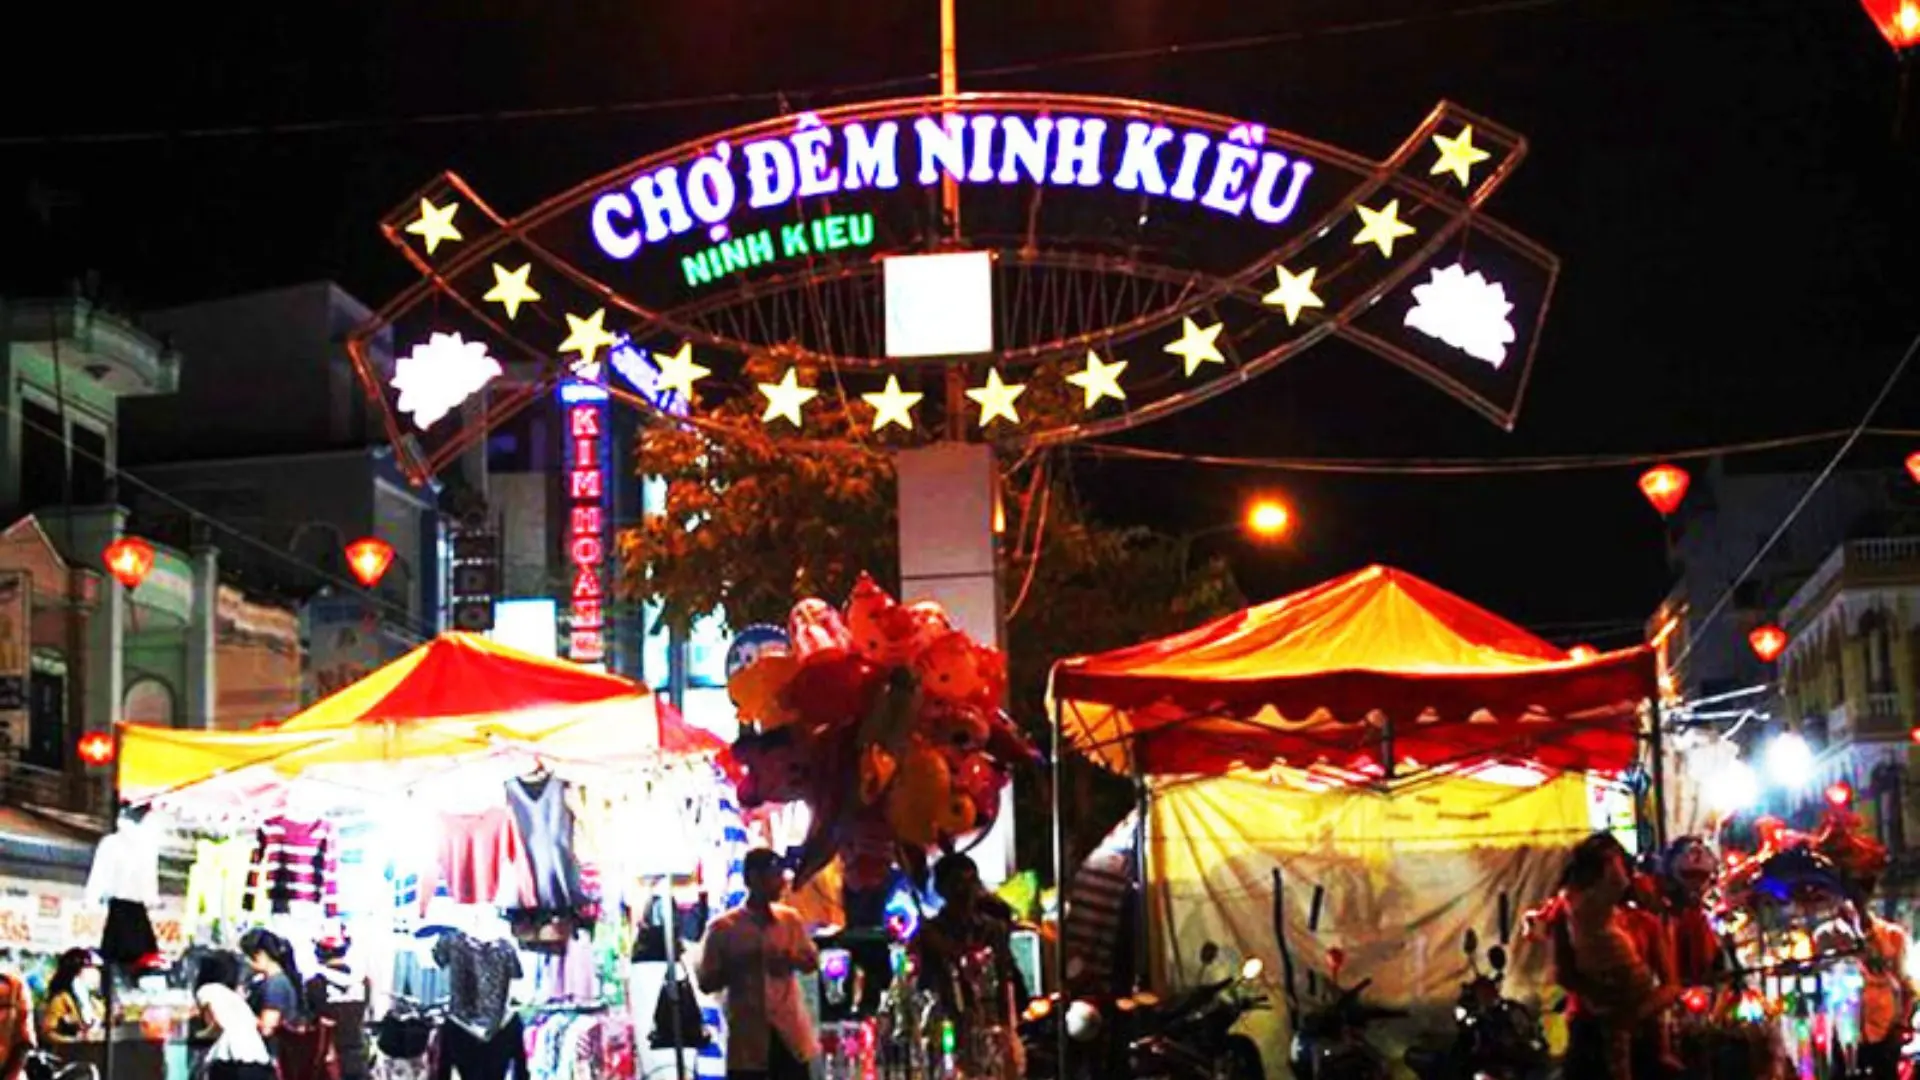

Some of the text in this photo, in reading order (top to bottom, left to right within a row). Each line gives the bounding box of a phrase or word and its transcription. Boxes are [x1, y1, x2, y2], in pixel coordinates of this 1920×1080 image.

[591, 140, 736, 260] CHỢ
[743, 111, 900, 209] ĐÊM
[913, 113, 1107, 187] NINH
[681, 213, 874, 287] NINH KIEU
[570, 406, 601, 498] KIM
